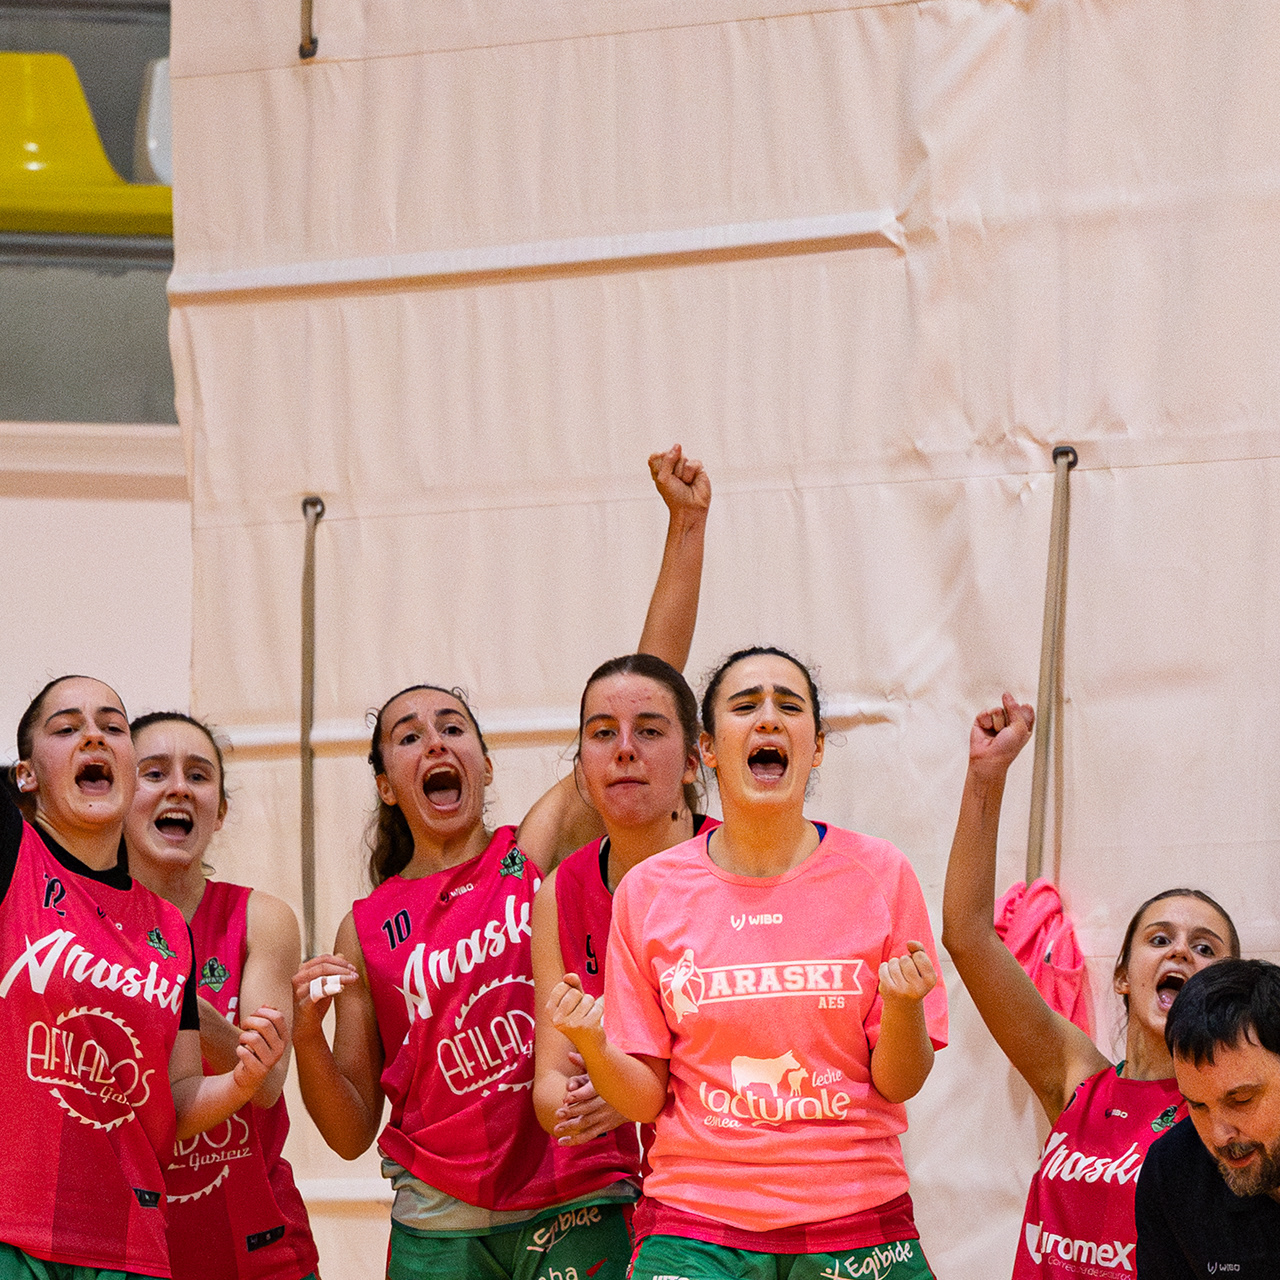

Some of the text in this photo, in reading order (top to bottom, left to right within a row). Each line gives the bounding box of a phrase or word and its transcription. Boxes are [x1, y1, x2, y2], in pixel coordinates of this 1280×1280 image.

[381, 909, 411, 950] 10
[748, 913, 783, 925] WIBO
[393, 878, 541, 1030] Arask
[708, 964, 845, 998] ARASKI
[818, 996, 846, 1010] AES
[437, 1009, 535, 1081] AFILAD
[812, 1068, 843, 1088] leche
[699, 1082, 851, 1122] lacturale
